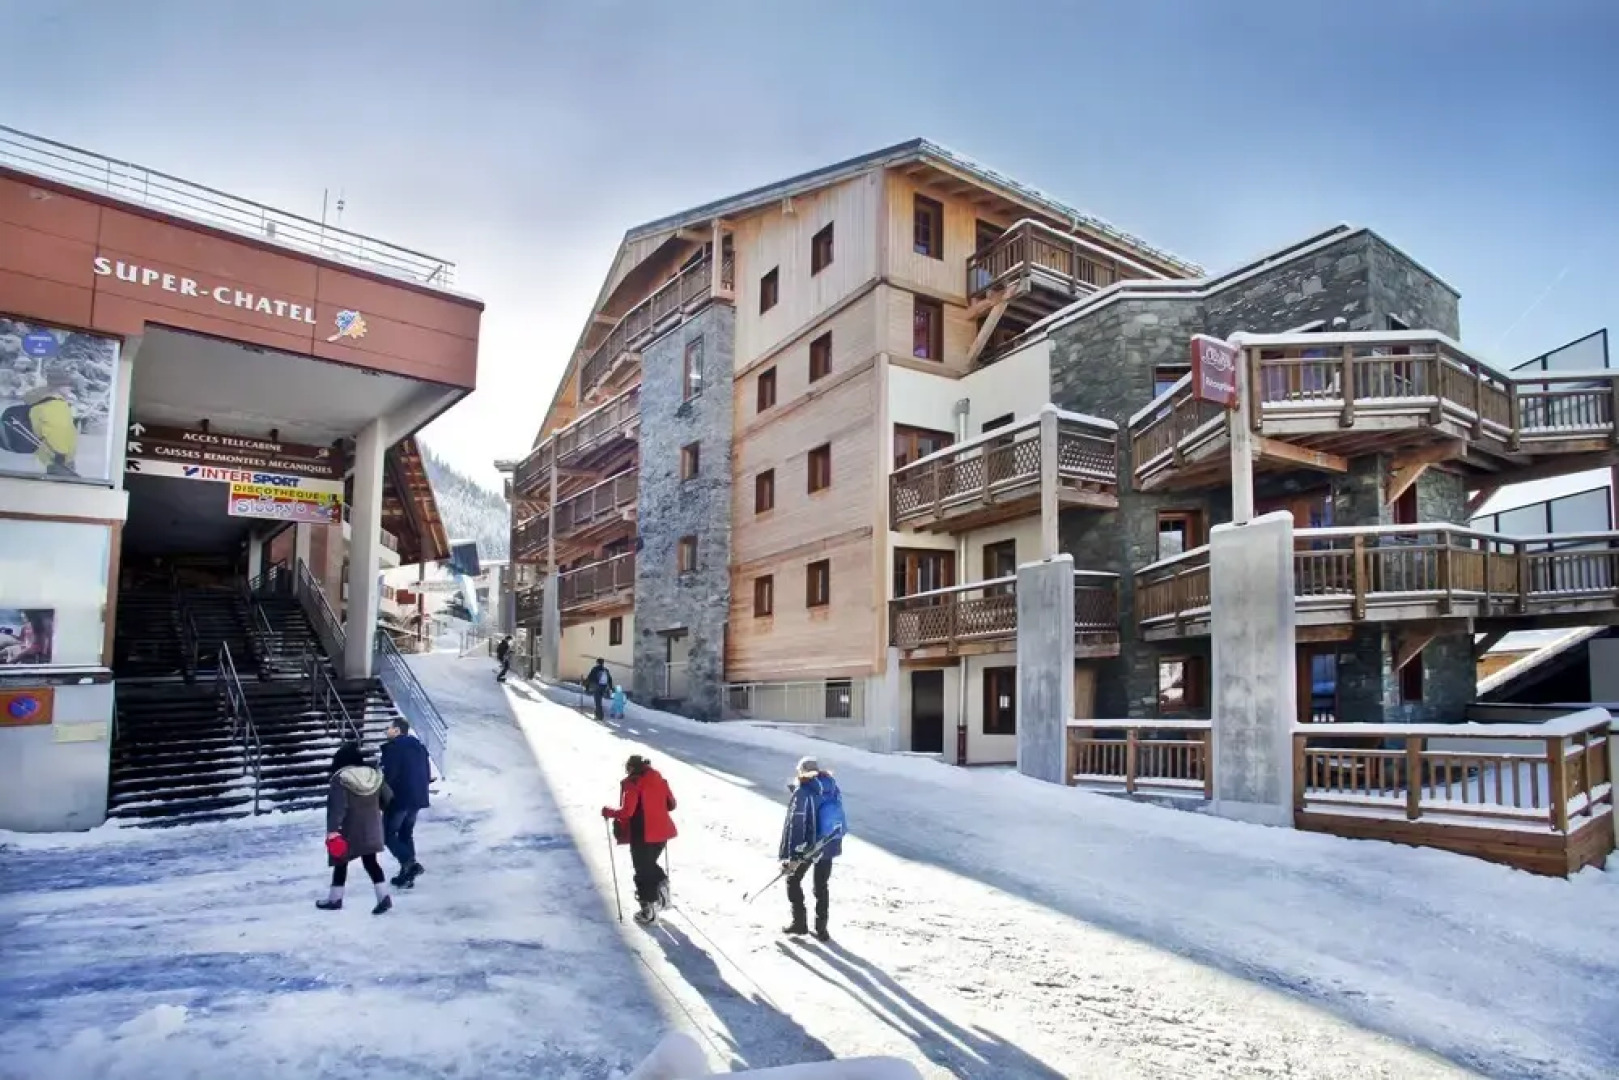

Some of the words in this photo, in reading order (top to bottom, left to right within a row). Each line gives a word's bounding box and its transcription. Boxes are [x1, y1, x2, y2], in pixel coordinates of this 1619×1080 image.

[93, 256, 317, 325] SUPER-CHATEL
[183, 432, 219, 444] ACCES
[221, 437, 282, 452] TELECABINE
[154, 446, 201, 459] CAISSES
[203, 452, 266, 467] REMONTEES
[268, 460, 333, 474] MECANIQUES
